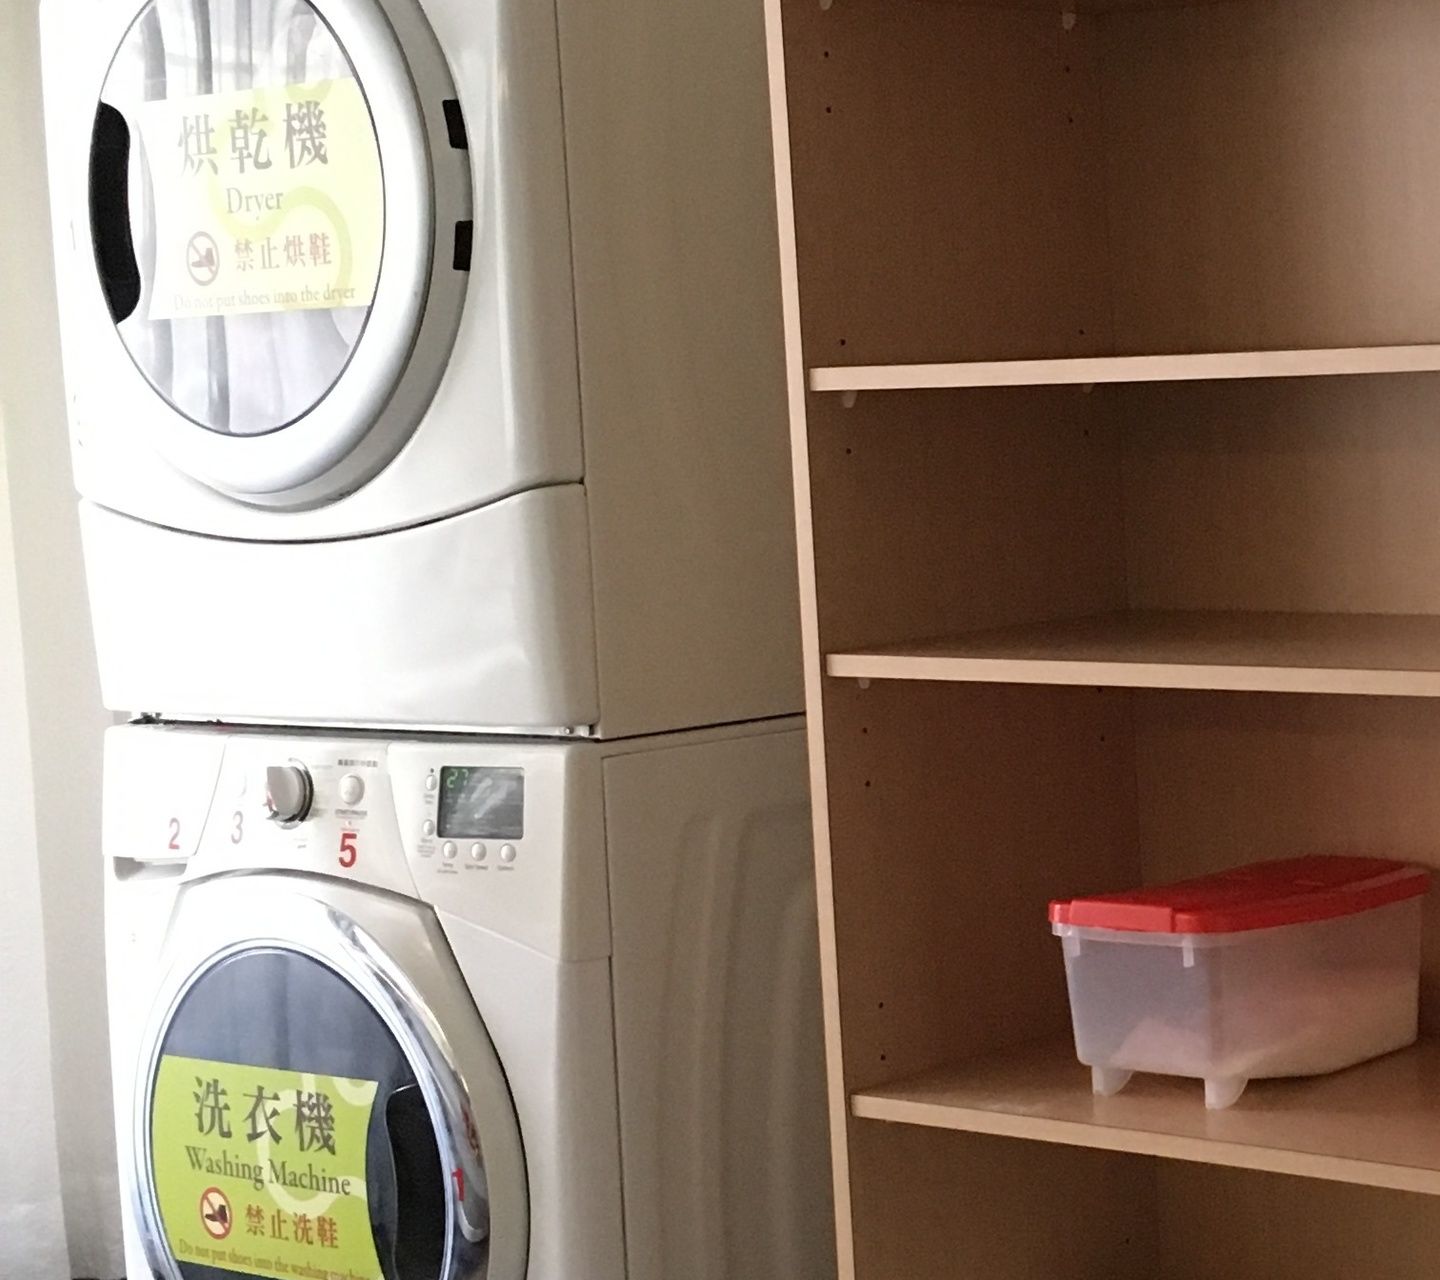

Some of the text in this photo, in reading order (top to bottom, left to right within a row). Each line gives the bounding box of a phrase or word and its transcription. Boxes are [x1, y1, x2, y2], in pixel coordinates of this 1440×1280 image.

[178, 100, 328, 176] 烘乾機
[226, 187, 284, 221] Dryer
[235, 232, 332, 272] 禁止烘鞋
[301, 284, 320, 302] the
[168, 817, 180, 850] 2
[231, 811, 244, 844] 3
[339, 833, 357, 868] 5
[193, 1076, 336, 1156] 洗衣機
[185, 1145, 351, 1196] Washing Machine
[451, 1167, 464, 1201] 1
[246, 1203, 340, 1249] 禁止洗鞋
